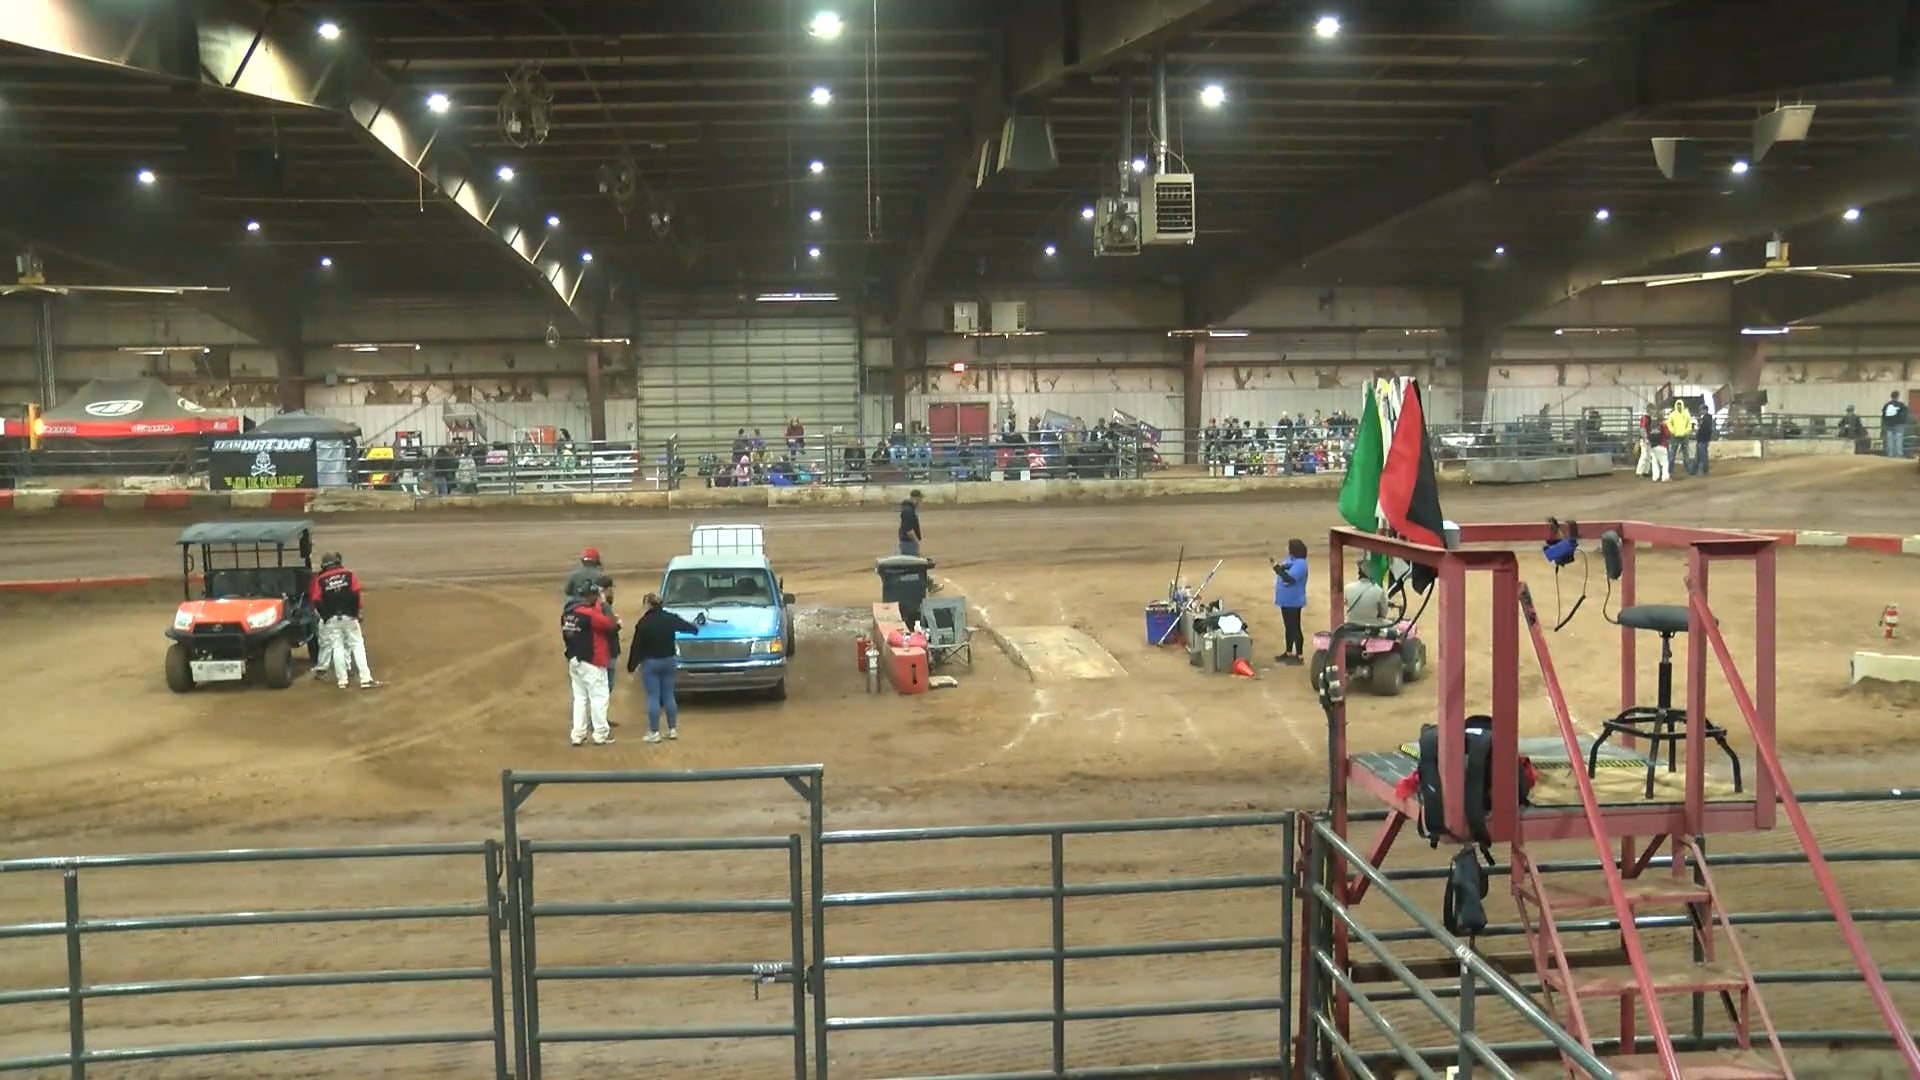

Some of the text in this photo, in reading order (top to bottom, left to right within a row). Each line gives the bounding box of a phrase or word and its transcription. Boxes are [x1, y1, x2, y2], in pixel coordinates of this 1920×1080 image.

[213, 437, 314, 453] TEAM DIRT DOG
